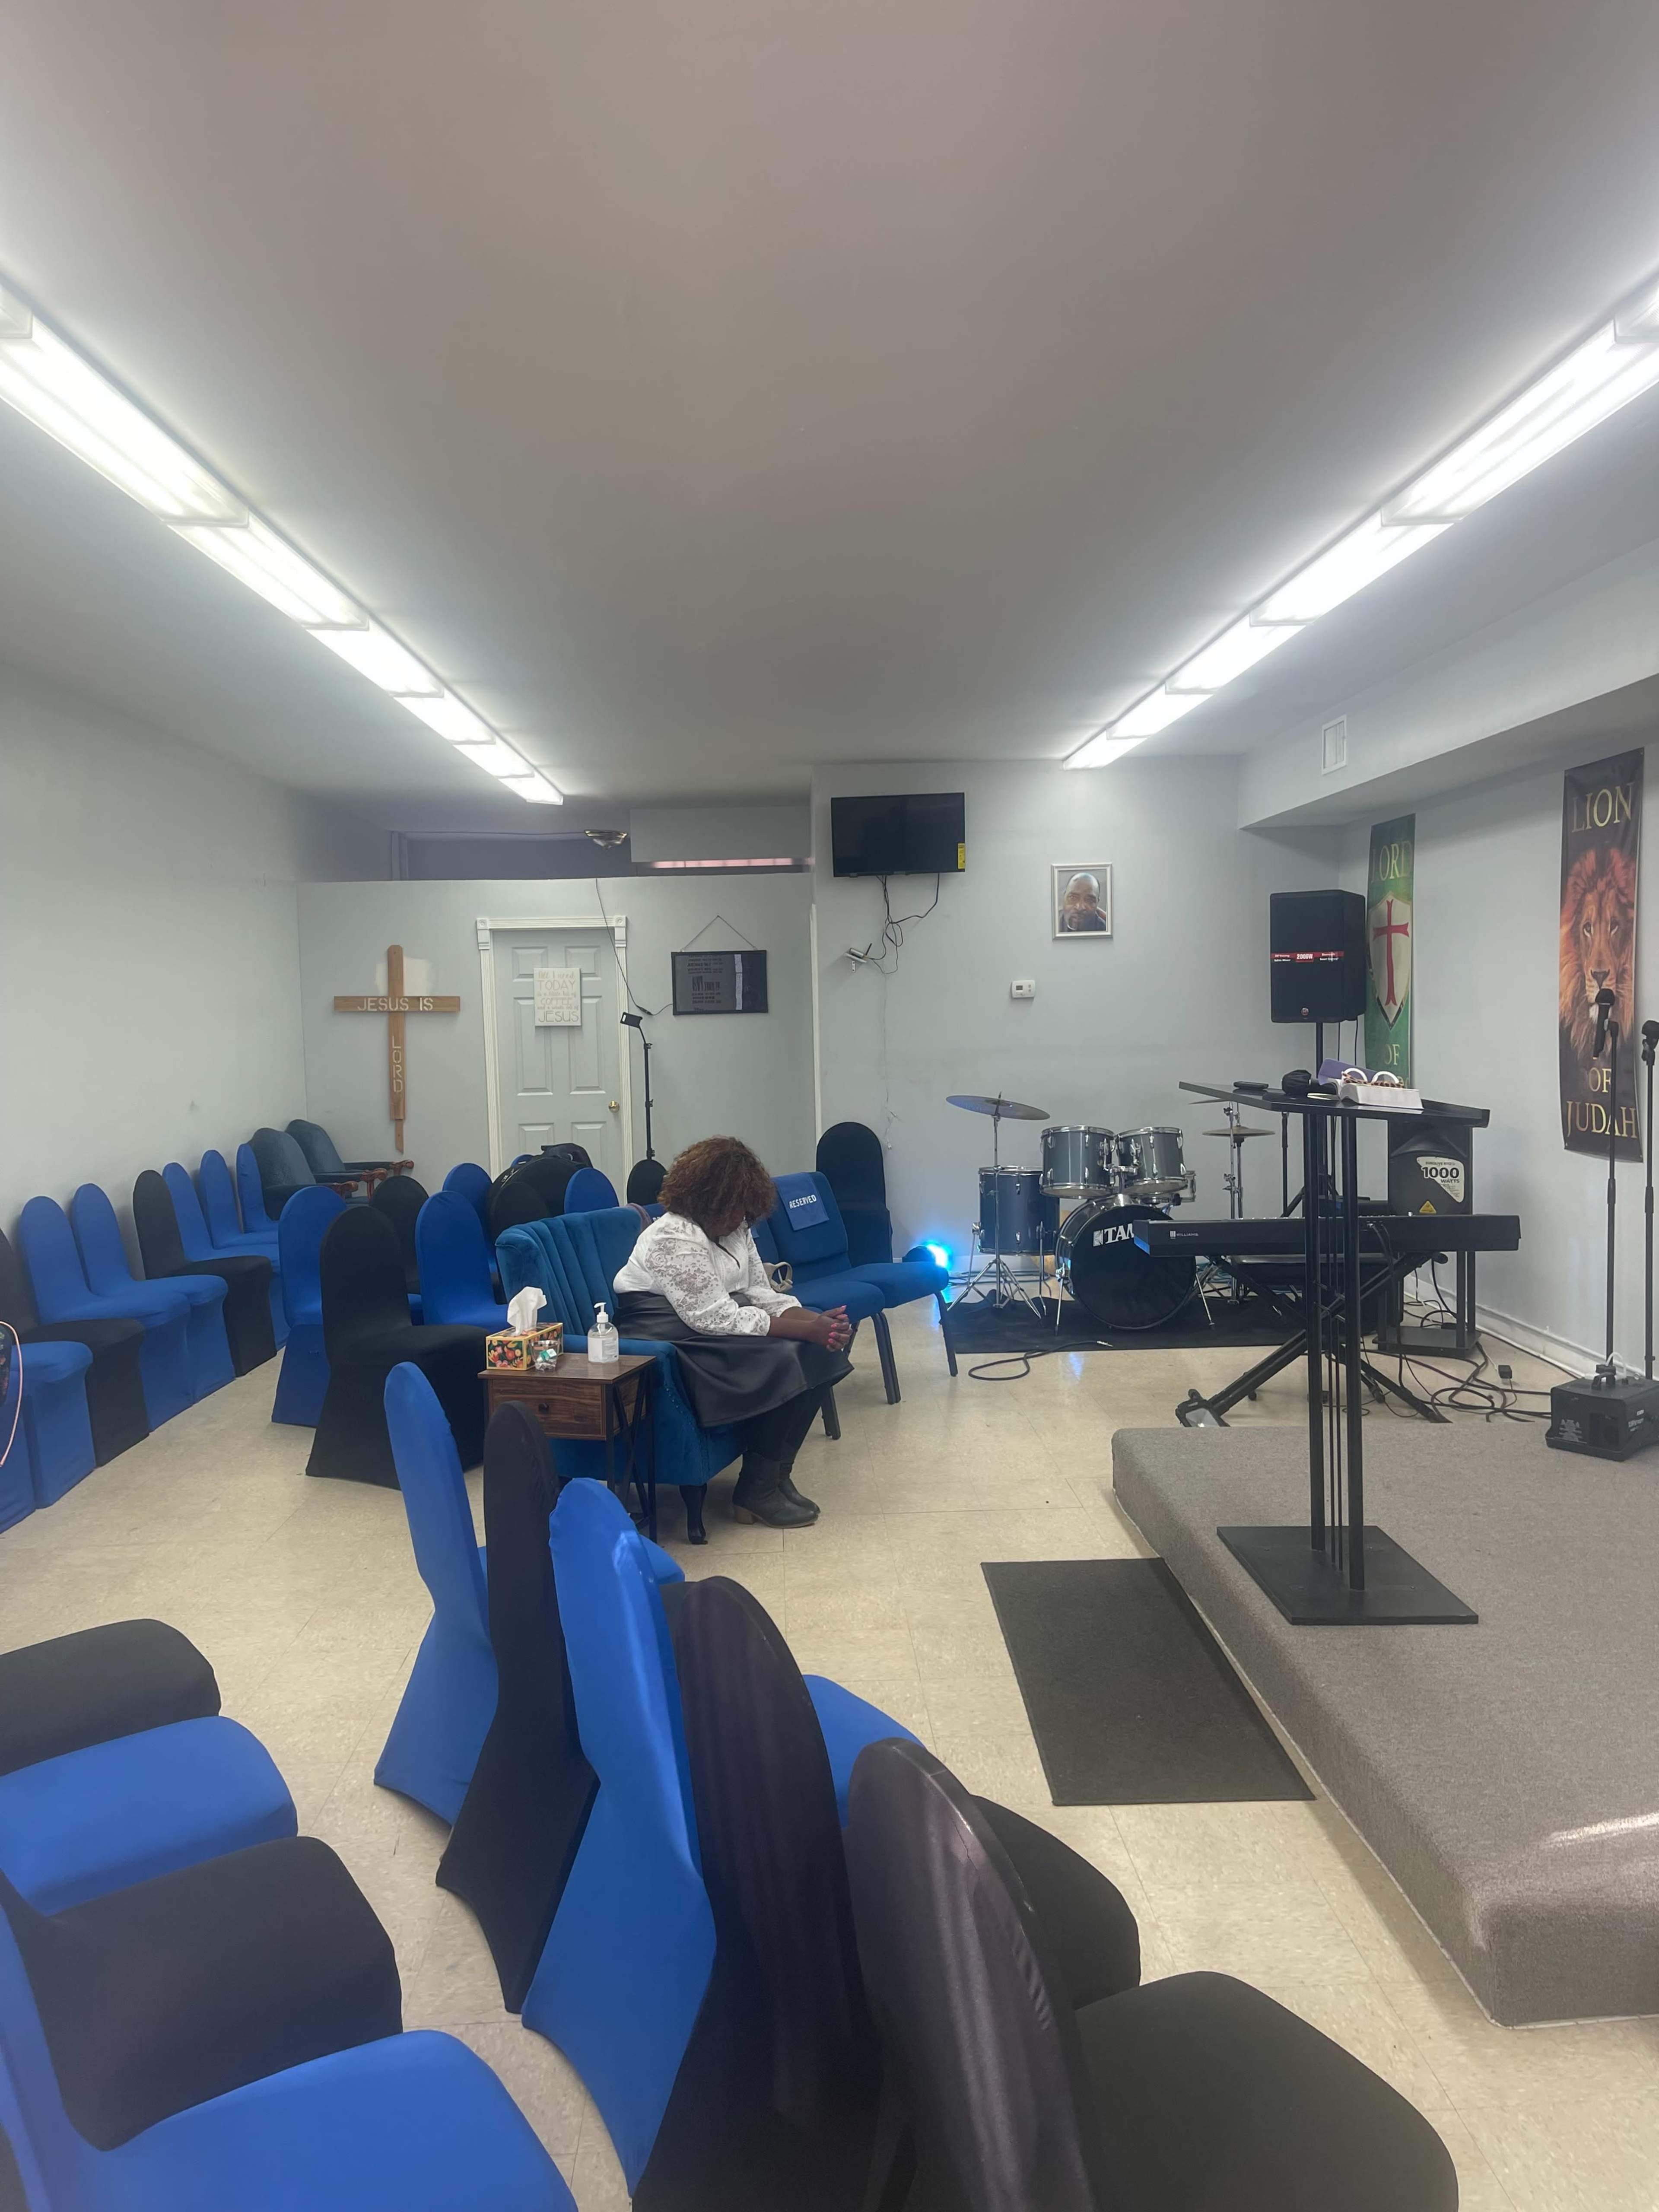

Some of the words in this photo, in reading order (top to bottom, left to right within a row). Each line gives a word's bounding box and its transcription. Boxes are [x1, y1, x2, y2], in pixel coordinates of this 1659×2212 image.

[1571, 782, 1635, 833] LION
[1370, 840, 1413, 884] LORD
[537, 979, 575, 991] TODAY
[357, 997, 409, 1011] JESUS
[419, 997, 433, 1011] IS
[538, 1011, 579, 1023] JESUS
[392, 1035, 403, 1093] LORD
[1383, 1043, 1400, 1066] OF
[1589, 1067, 1612, 1093] OF
[1567, 1101, 1637, 1138] JUDAH
[1422, 1167, 1460, 1179] 1000
[789, 1194, 817, 1209] RESERVED
